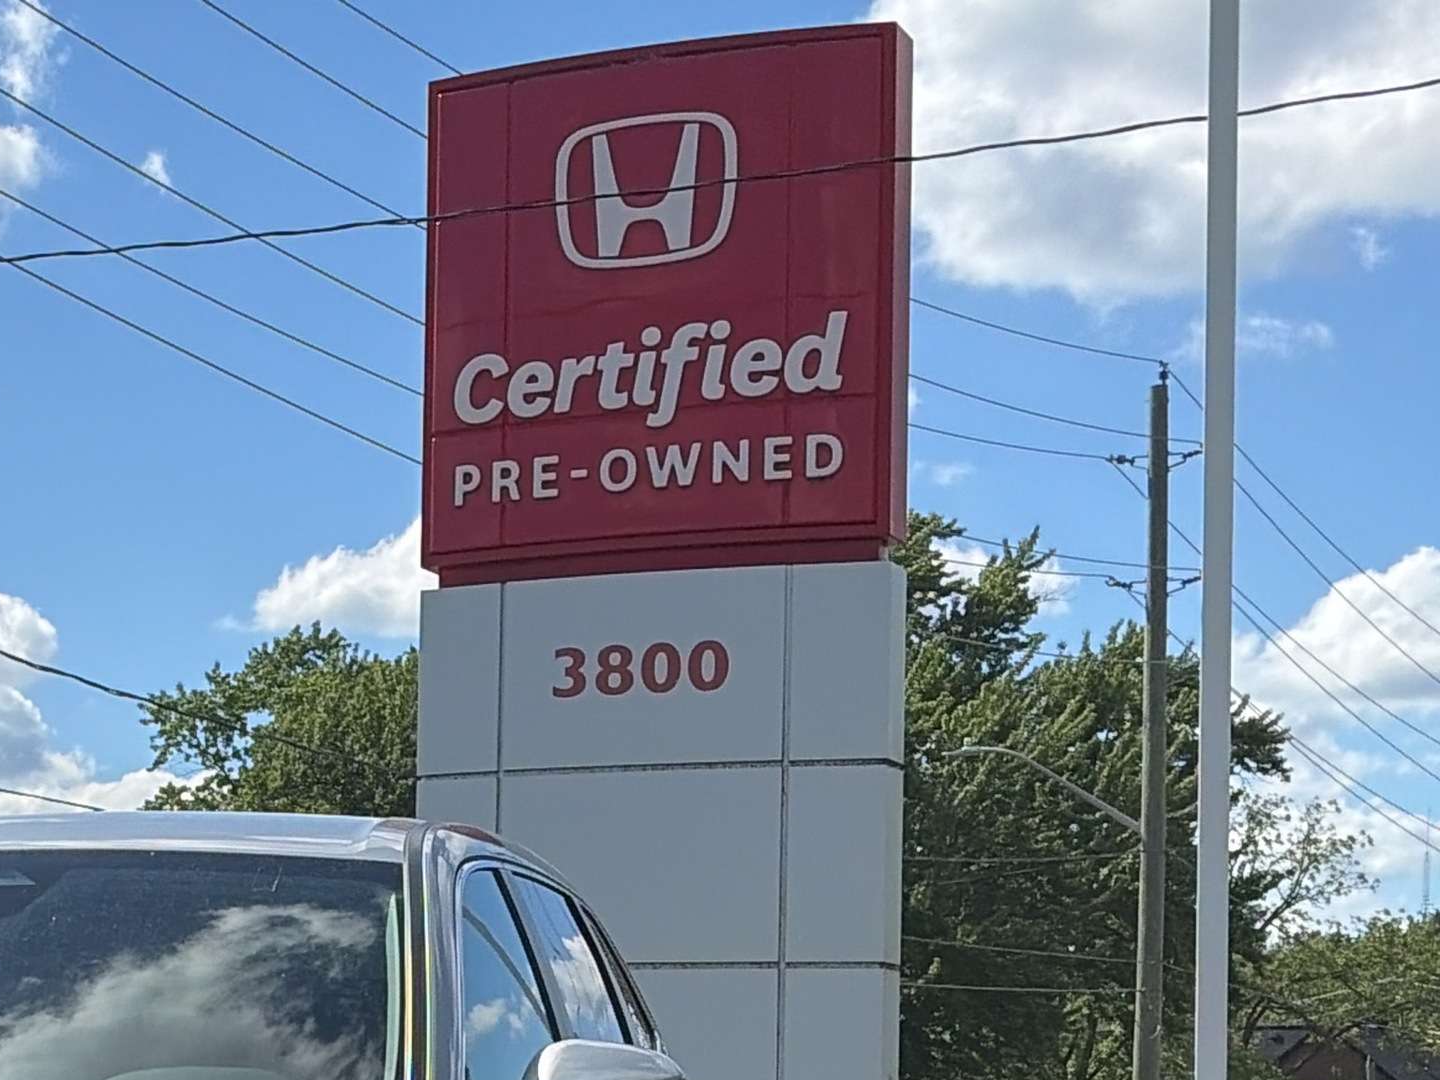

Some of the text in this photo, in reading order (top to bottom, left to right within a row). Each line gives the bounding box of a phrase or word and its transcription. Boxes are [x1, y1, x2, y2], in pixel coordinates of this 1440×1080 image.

[453, 310, 848, 428] Certified
[453, 433, 844, 507] PRE-OWNED
[551, 639, 730, 698] 3800
